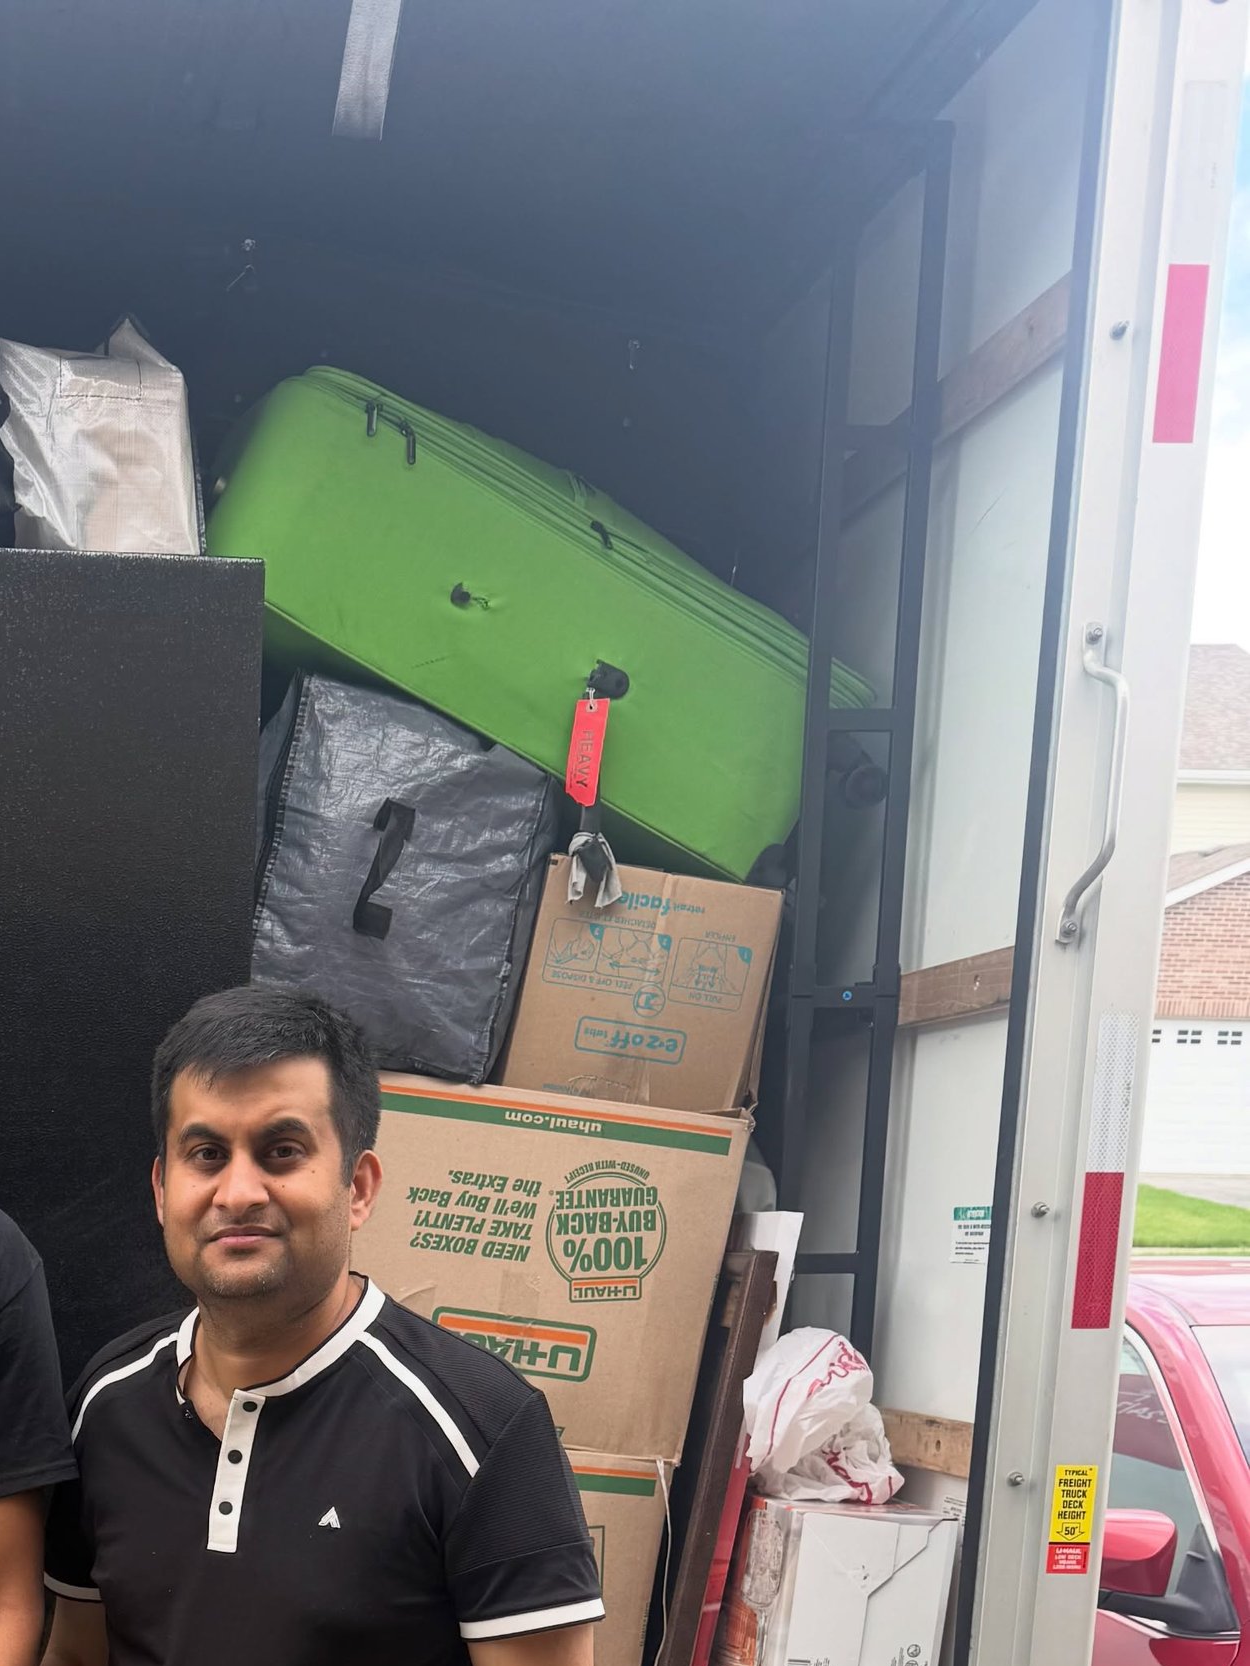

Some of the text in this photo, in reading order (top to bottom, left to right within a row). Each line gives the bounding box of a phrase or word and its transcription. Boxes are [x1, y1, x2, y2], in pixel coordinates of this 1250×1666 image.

[576, 730, 595, 788] HEAVY
[616, 891, 671, 916] facile
[584, 1027, 608, 1039] tabs
[504, 1110, 603, 1134] uhaul.com
[448, 1169, 542, 1198] the Extras.
[564, 1162, 594, 1184] RECEIPT
[406, 1186, 537, 1220] We'll Buy Back
[556, 1186, 658, 1210] GUARANTEE
[412, 1209, 534, 1241] TAKE PLENTY!
[556, 1210, 657, 1236] BUY-BACK
[409, 1232, 531, 1262] NEED BOXES?
[562, 1236, 648, 1273] 100%
[574, 1286, 637, 1299] U-HAUL
[1058, 1478, 1092, 1488] FREIGHT
[1065, 1469, 1088, 1477] TYPICAL
[1062, 1490, 1087, 1498] TRUCK
[1062, 1500, 1083, 1509] DECK
[1058, 1511, 1086, 1520] HEIGHT
